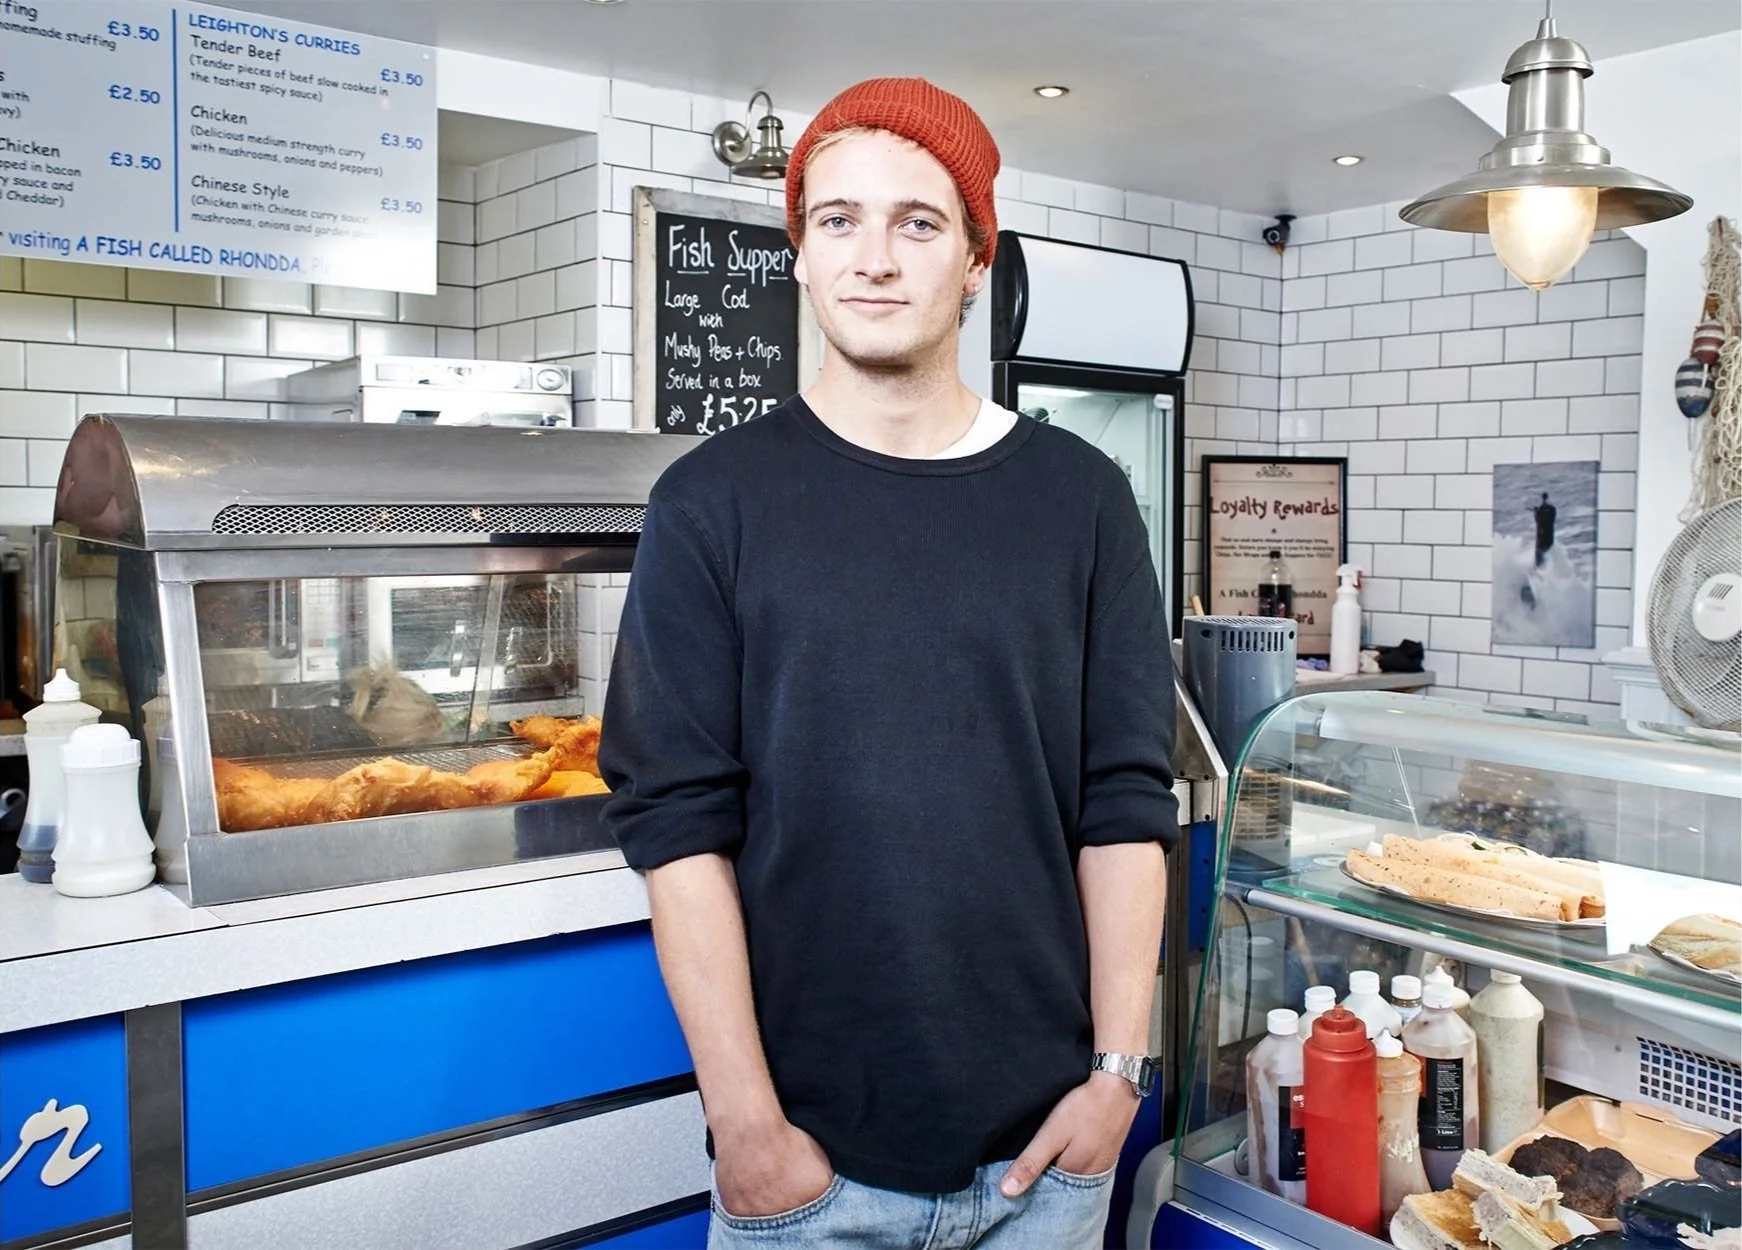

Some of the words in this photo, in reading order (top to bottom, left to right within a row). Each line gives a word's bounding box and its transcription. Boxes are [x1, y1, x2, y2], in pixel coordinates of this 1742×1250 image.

[65, 32, 117, 52] stuffing
[107, 21, 160, 42] £3.50
[188, 13, 289, 43] LEIGHTON'S
[295, 34, 361, 55] CURRIES
[190, 34, 243, 55] Tender
[248, 44, 282, 62] Beef
[189, 54, 234, 71] (Tender
[237, 63, 271, 79] pieces
[274, 69, 287, 80] of
[289, 71, 314, 84] beef
[317, 77, 339, 89] slow
[342, 81, 377, 95] cooked
[379, 86, 389, 97] in
[190, 70, 210, 84] the
[213, 74, 256, 91] tastiest
[260, 83, 287, 98] spicy
[289, 89, 323, 102] sauce)
[380, 68, 423, 86] £3.50
[2, 89, 31, 102] with
[108, 84, 161, 105] £2.50
[190, 105, 248, 125] Chicken
[0, 137, 61, 158] Chicken
[190, 124, 244, 142] (Delicious
[247, 134, 287, 149] medium
[290, 139, 336, 156] strength
[338, 146, 366, 160] curry
[380, 132, 423, 150] £3.50
[30, 161, 43, 173] in
[46, 162, 82, 178] bacon
[109, 151, 162, 171] £3.50
[190, 141, 215, 154] with
[218, 146, 282, 164] mushrooms,
[284, 154, 316, 168] onions
[318, 158, 337, 170] and
[340, 163, 384, 178] peppers)
[13, 177, 48, 190] sauce
[51, 181, 74, 192] and
[191, 175, 248, 194] Chinese
[252, 182, 290, 199] Style
[6, 190, 64, 208] Cheddar)
[191, 194, 239, 210] (Chicken
[241, 200, 265, 213] with
[267, 203, 308, 219] Chinese
[310, 210, 339, 223] curry
[380, 197, 423, 214] £3.50
[258, 219, 291, 232] onions
[293, 222, 312, 234] and
[8, 230, 71, 256] visiting
[76, 235, 89, 253] A
[96, 235, 143, 258] FISH
[149, 242, 213, 265] CALLED
[668, 225, 715, 269] Fish
[727, 229, 794, 287] Supper
[665, 280, 701, 317] Large
[721, 284, 751, 310] Cod
[699, 313, 724, 328] with
[664, 332, 701, 368] Mushy
[707, 334, 733, 361] Peas
[665, 368, 704, 390] Served
[709, 374, 720, 389] in
[724, 376, 734, 389] a
[739, 368, 762, 388] box
[667, 405, 686, 426] only
[1210, 496, 1268, 519] Loyalty
[1273, 497, 1340, 520] Rewards
[1229, 589, 1249, 599] Fish
